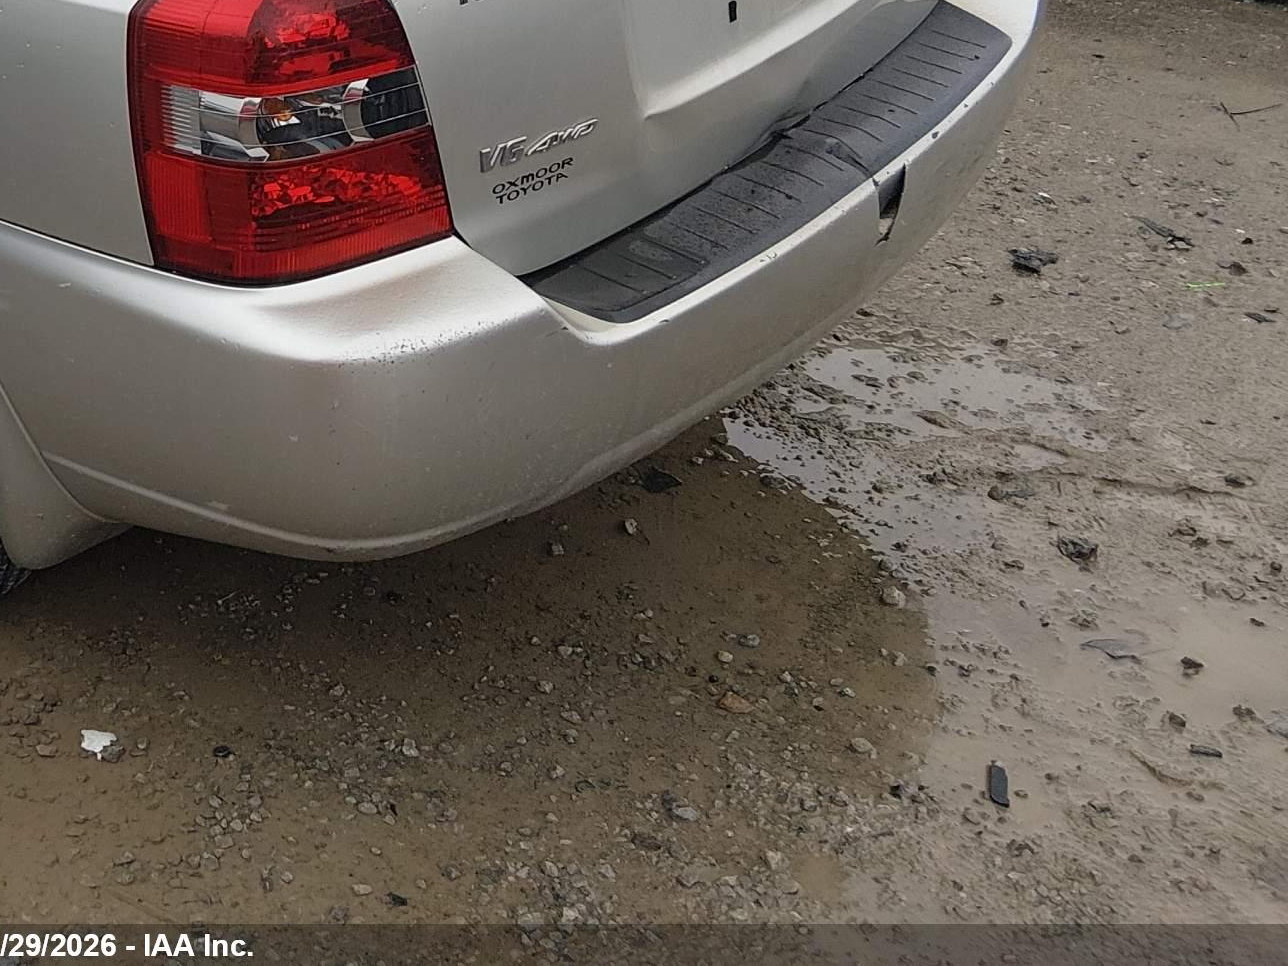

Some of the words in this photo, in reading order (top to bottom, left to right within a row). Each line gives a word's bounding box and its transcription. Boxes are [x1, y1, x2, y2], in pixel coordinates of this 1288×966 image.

[479, 136, 528, 173] V6
[524, 118, 600, 156] 4WD
[492, 157, 574, 195] OXMOOR
[496, 172, 569, 205] TOYOTA
